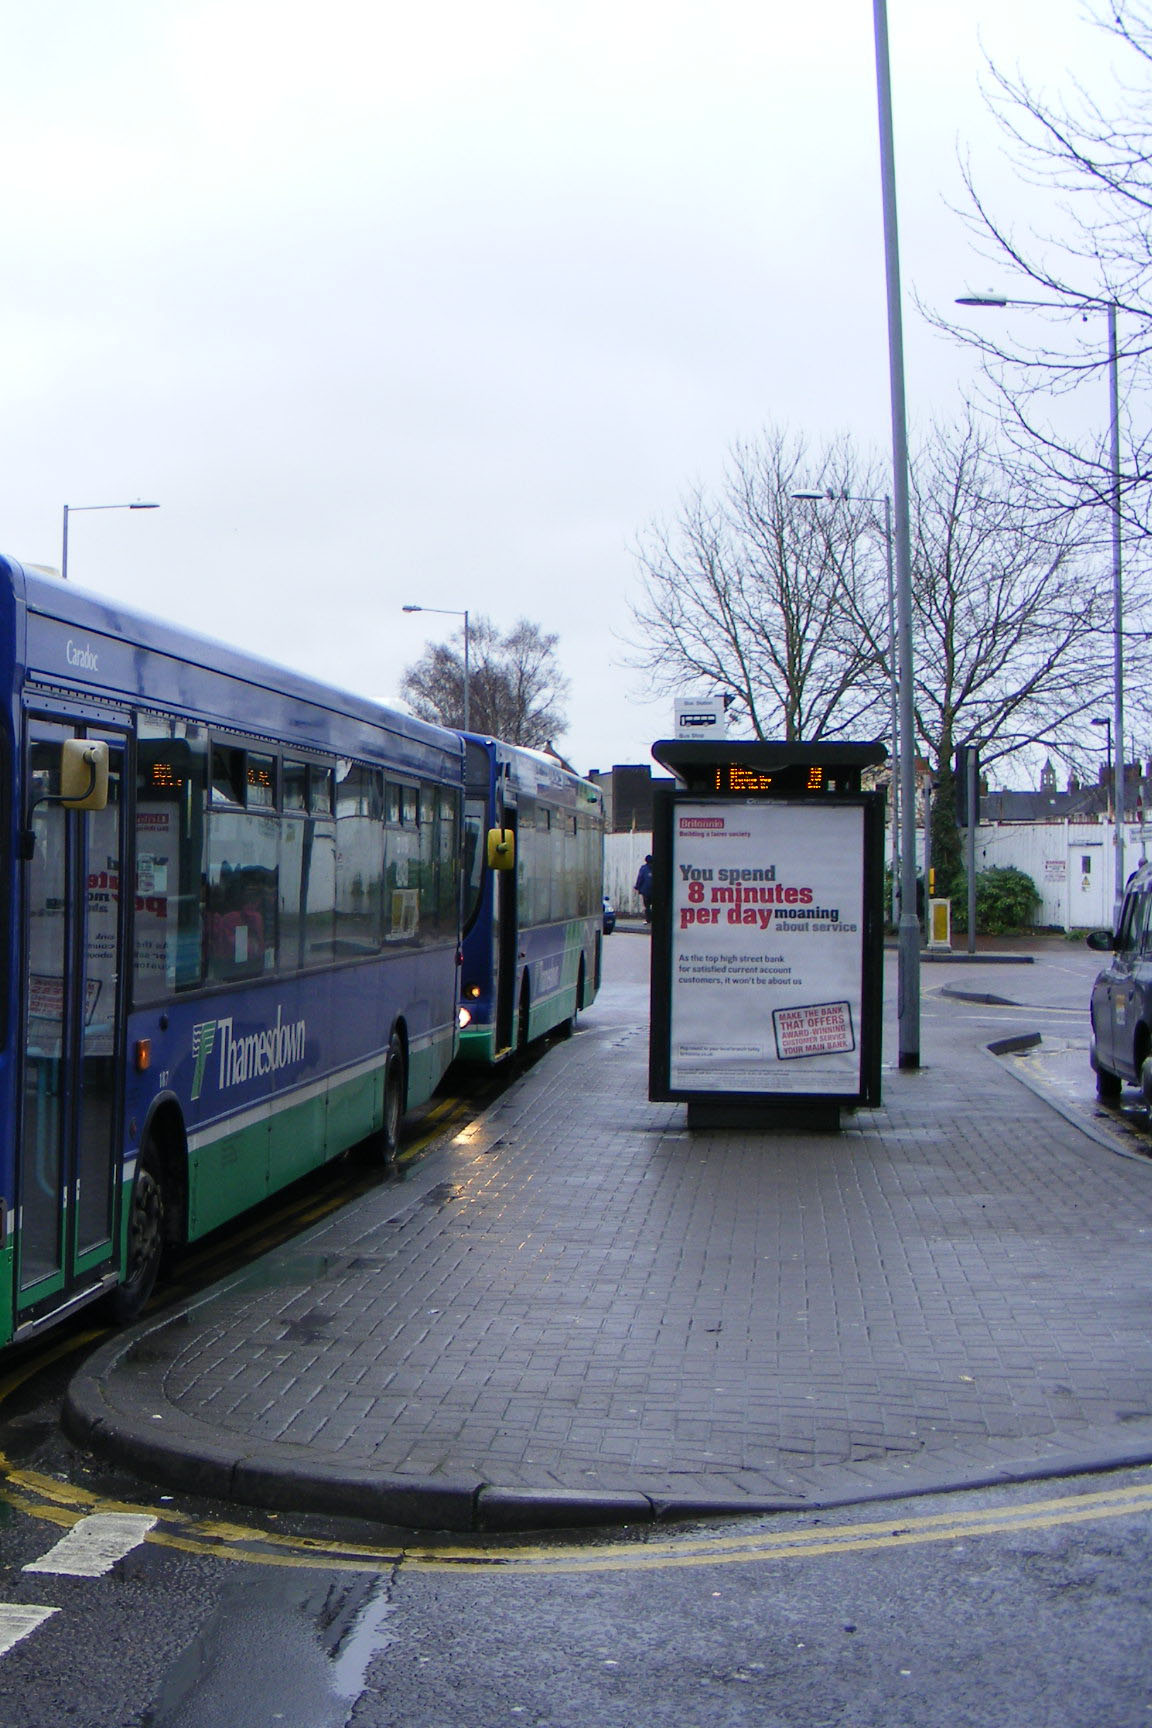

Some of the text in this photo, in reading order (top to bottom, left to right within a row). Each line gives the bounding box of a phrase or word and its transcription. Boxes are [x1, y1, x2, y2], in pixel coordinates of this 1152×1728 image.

[67, 640, 98, 671] Caradoc
[680, 865, 776, 885] You spend
[688, 882, 813, 903] 8 minutes
[680, 902, 839, 930] per day moaning
[776, 922, 857, 932] about service
[691, 954, 704, 962] the
[705, 955, 718, 964] top
[720, 954, 737, 963] high
[764, 955, 785, 963] bank
[679, 965, 690, 973] for
[759, 966, 792, 974] account
[218, 1005, 305, 1090] Thamesdown
[159, 1070, 169, 1088] 187
